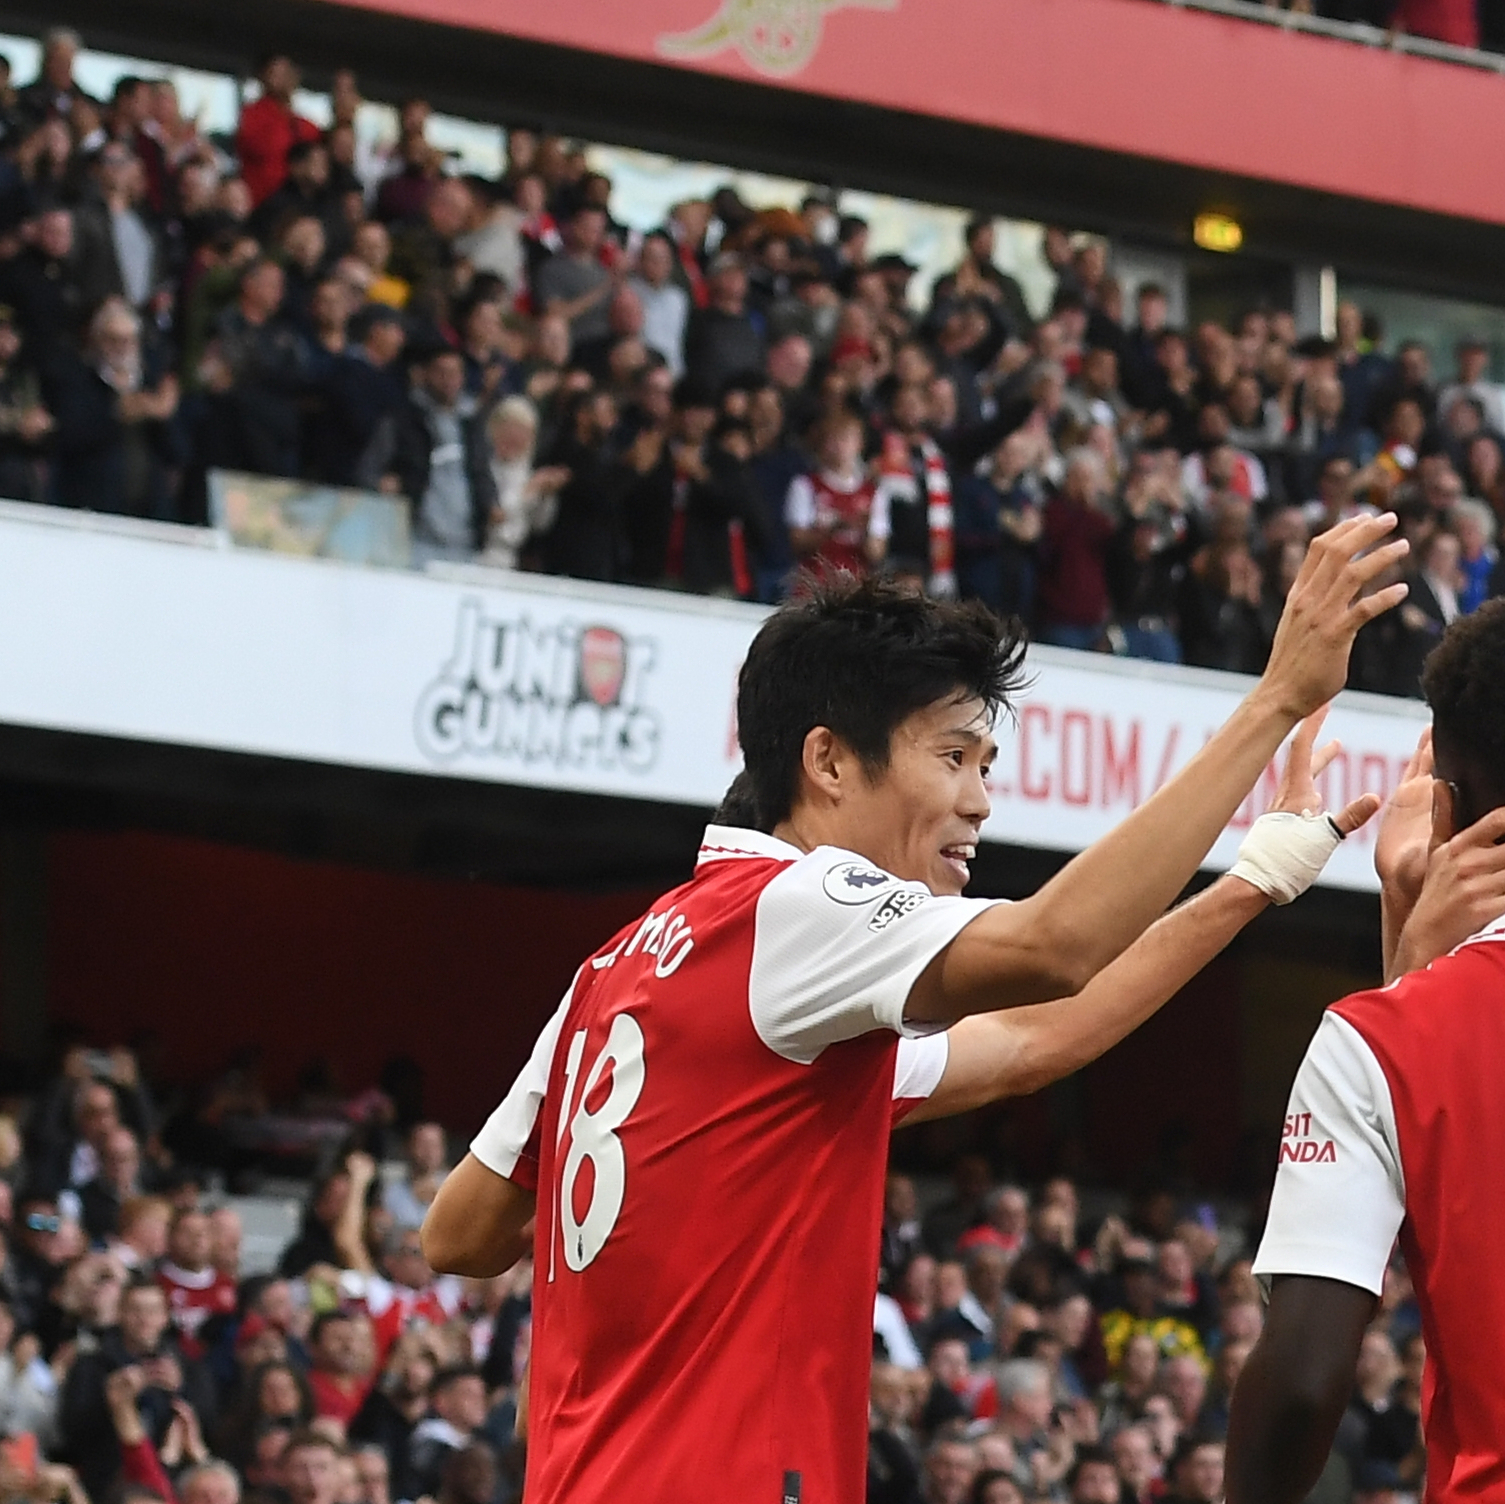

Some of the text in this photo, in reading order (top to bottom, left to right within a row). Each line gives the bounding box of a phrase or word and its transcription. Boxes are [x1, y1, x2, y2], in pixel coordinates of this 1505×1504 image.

[1282, 1112, 1312, 1138] SIT
[547, 1012, 646, 1284] 18
[1279, 1140, 1337, 1164] NDA
